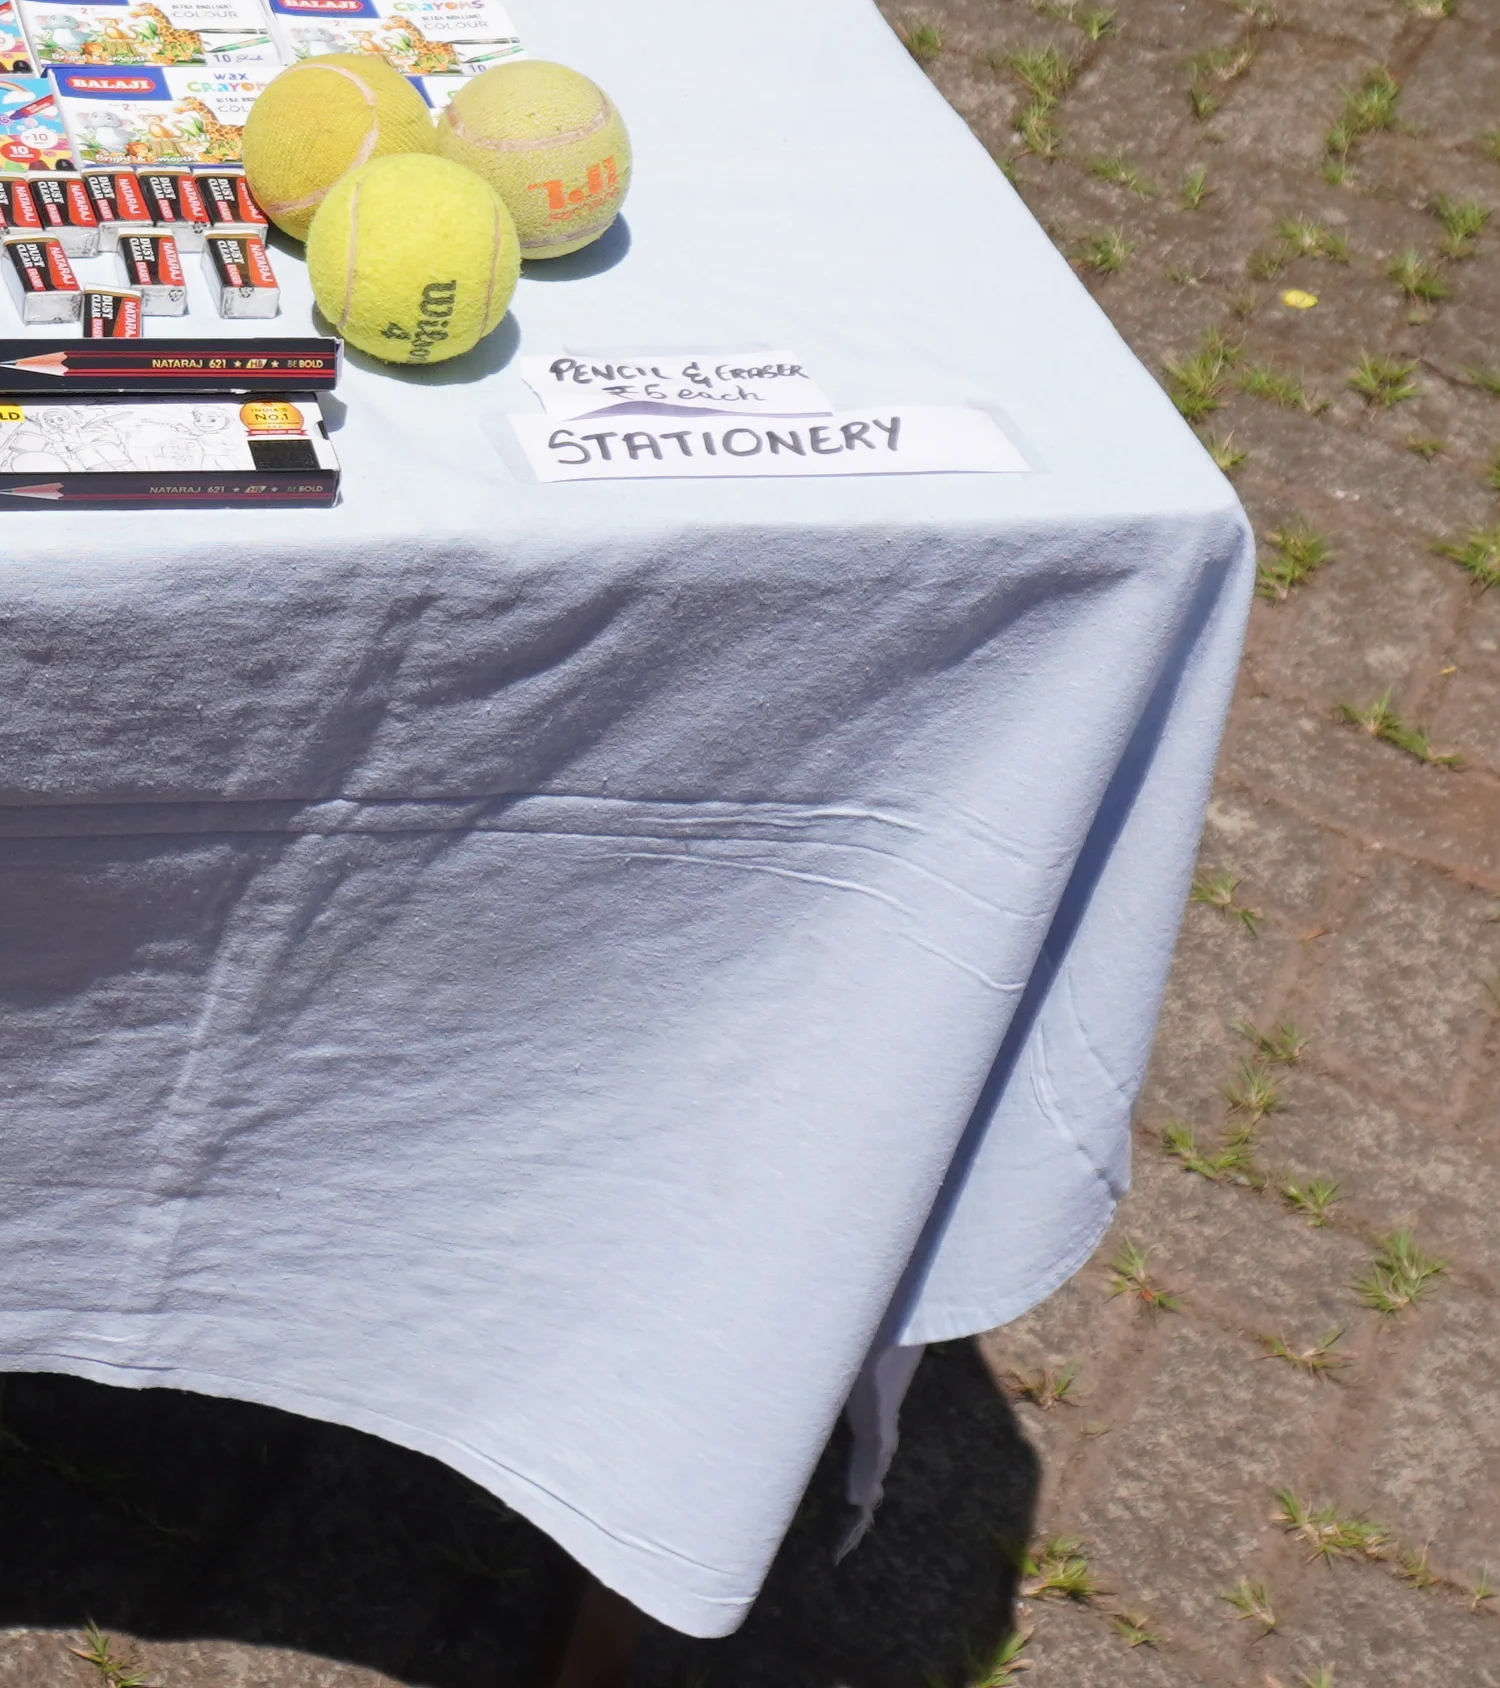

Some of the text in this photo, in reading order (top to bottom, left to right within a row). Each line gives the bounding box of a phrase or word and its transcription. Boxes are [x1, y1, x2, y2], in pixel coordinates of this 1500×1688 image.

[283, 0, 358, 9] BALAJI
[74, 80, 149, 89] BALAJI
[48, 182, 64, 204] DUST
[98, 176, 115, 199] DUST
[118, 179, 141, 214] NATARAJ
[159, 177, 176, 200] DUST
[181, 181, 203, 217] NATARAJ
[218, 179, 235, 201] DUST
[15, 186, 36, 222] NATARAJ
[70, 185, 93, 221] NATARAJ
[26, 244, 45, 268] DUST
[139, 238, 155, 261] DUST
[162, 242, 182, 280] NATARAJ
[227, 241, 244, 264] DUST
[51, 247, 75, 285] NATARAJ
[250, 244, 273, 282] NATARAJ
[102, 296, 113, 319] DUST
[152, 360, 202, 368] NATARAJ
[209, 360, 226, 368] 621
[288, 360, 297, 368] BE
[299, 360, 323, 368] BOLD
[550, 358, 673, 383] PENCIL
[549, 416, 901, 464] STATIONERY
[208, 485, 225, 493] 621
